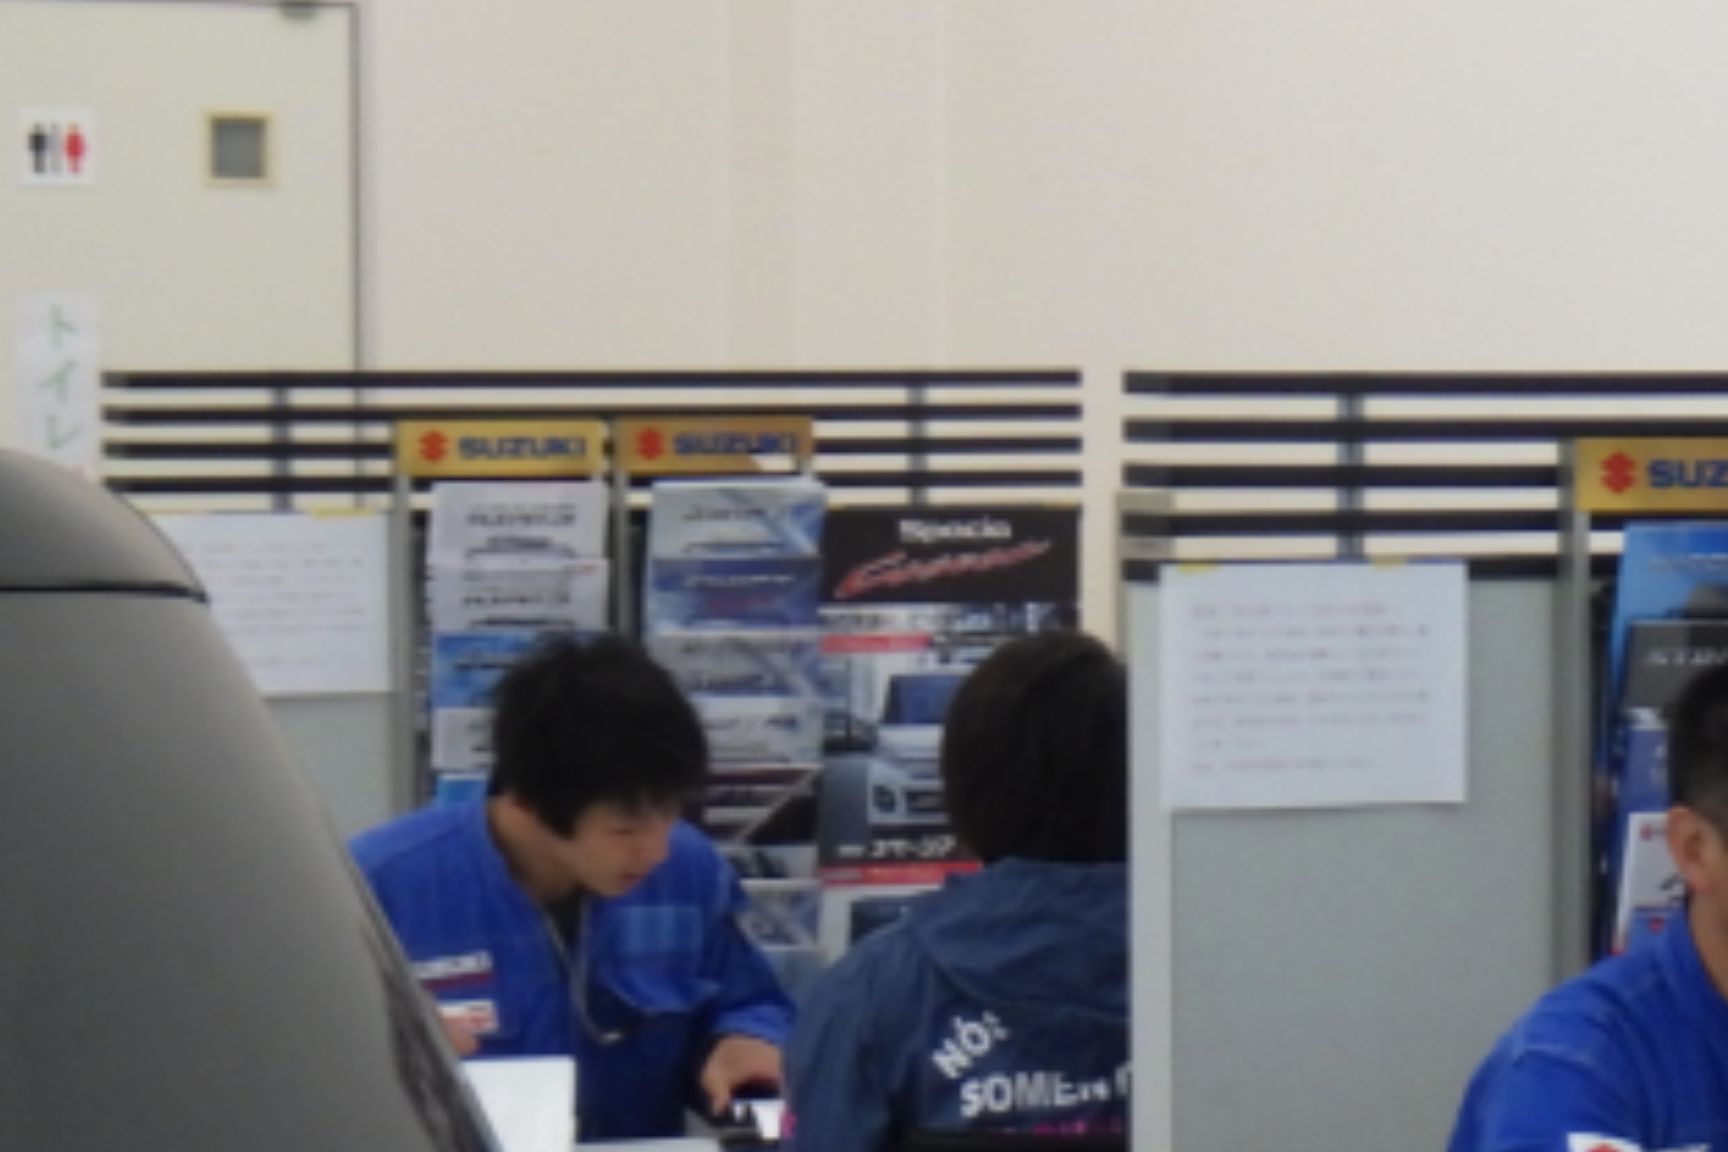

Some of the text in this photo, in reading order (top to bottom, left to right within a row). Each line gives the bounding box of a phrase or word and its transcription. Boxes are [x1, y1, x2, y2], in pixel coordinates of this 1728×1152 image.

[38, 304, 83, 449] トイレ
[458, 436, 587, 460] SUZUKI
[673, 432, 798, 456] SUZUKI
